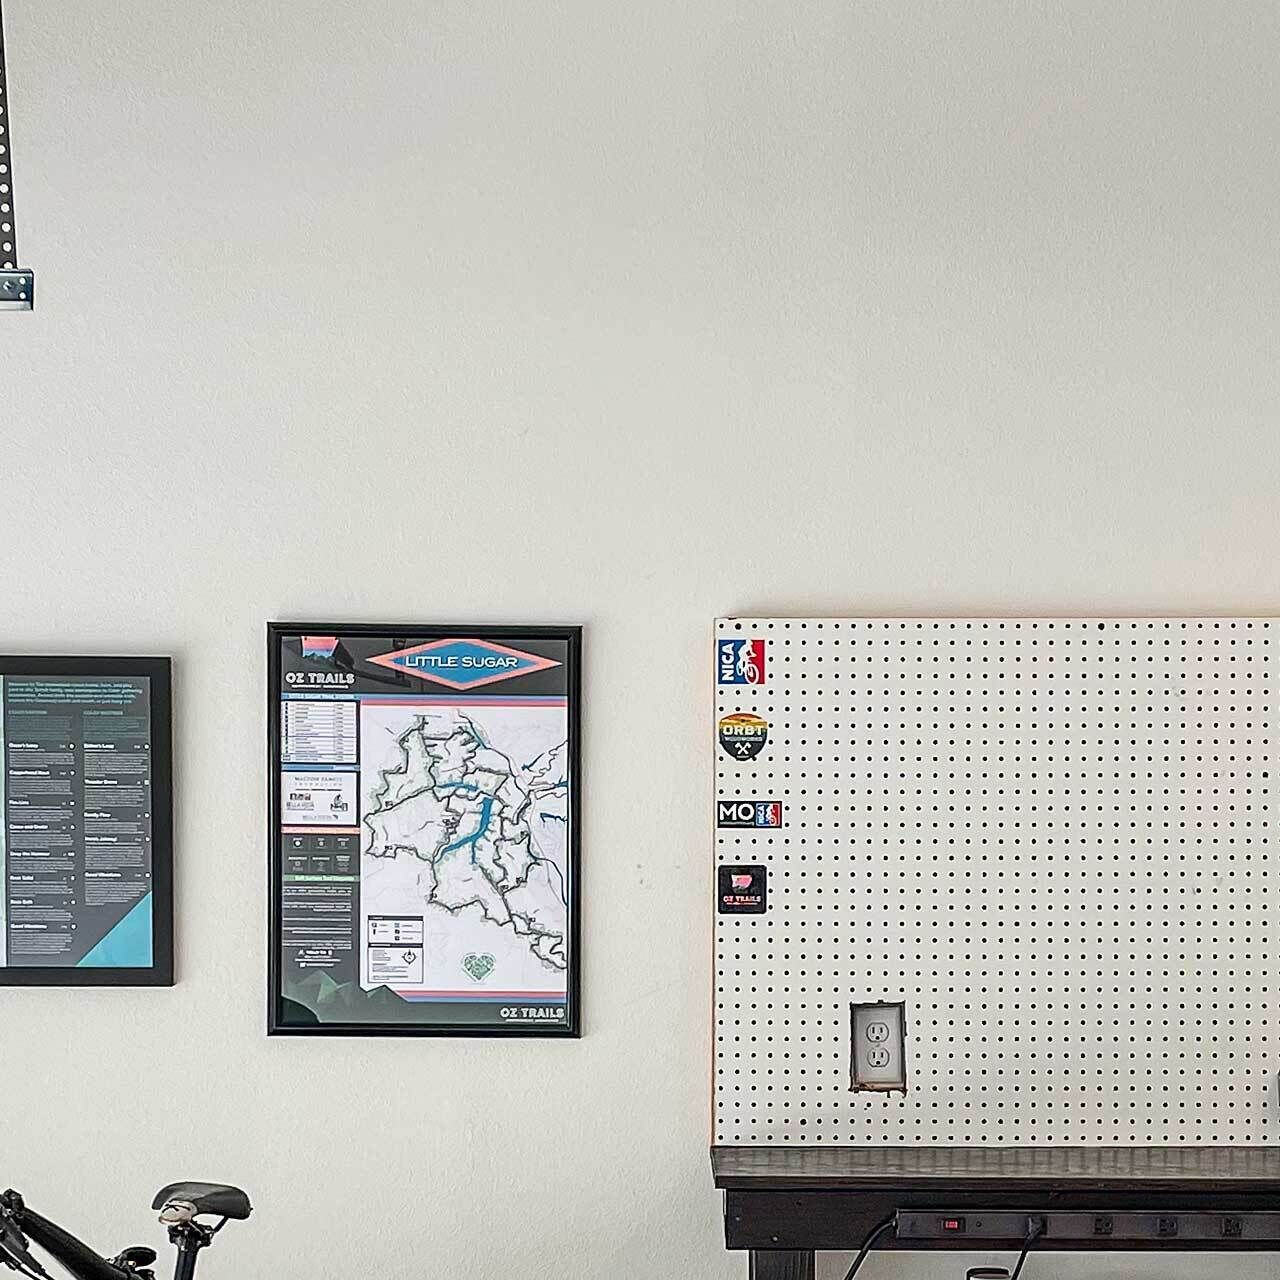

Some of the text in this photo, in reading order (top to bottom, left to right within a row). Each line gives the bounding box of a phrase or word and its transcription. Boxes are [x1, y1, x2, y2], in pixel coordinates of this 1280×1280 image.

[405, 656, 517, 667] LITTLE SUGAR
[722, 642, 735, 681] NICA
[285, 672, 355, 684] OZ TRAILS
[719, 803, 755, 821] MO
[500, 1007, 565, 1018] OZ TRAILS
